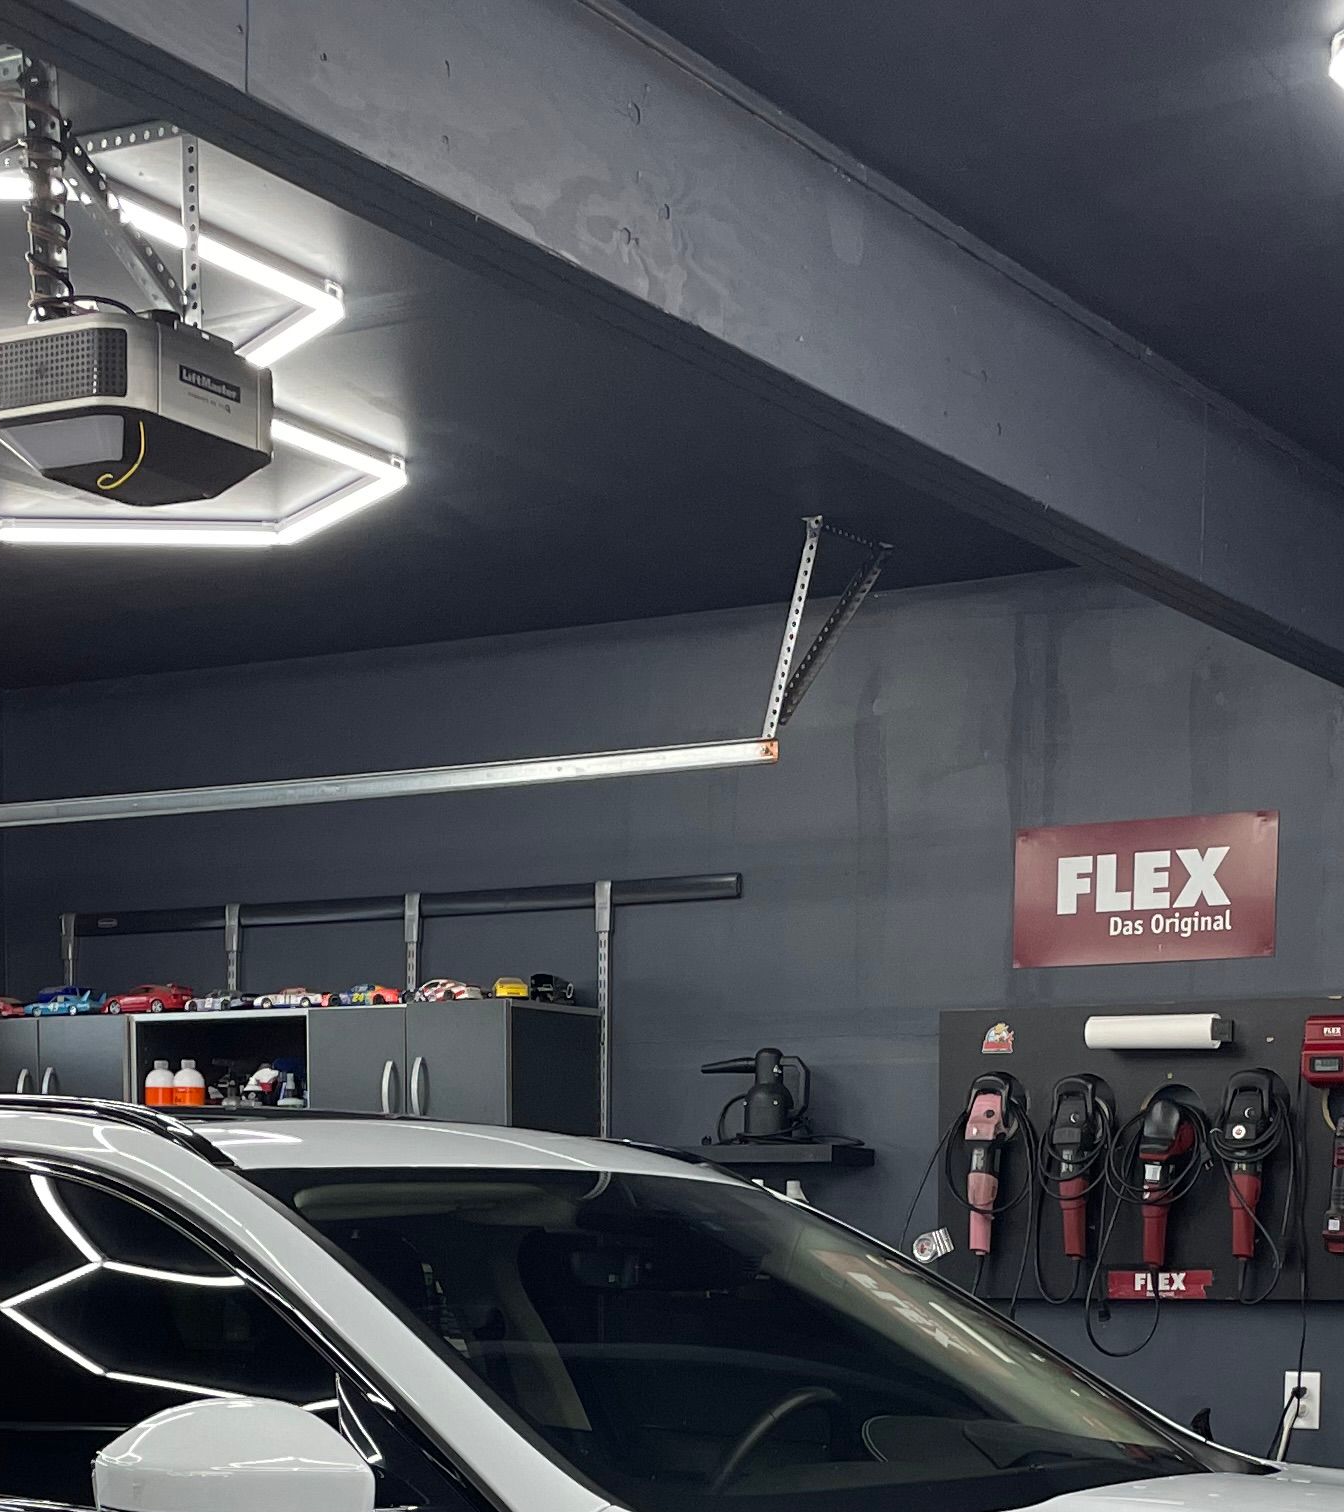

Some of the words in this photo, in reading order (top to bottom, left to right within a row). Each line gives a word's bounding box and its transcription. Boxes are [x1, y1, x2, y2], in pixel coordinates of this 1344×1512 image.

[1057, 846, 1231, 915] FLEX
[1109, 916, 1144, 936] Das
[1150, 909, 1232, 938] Original
